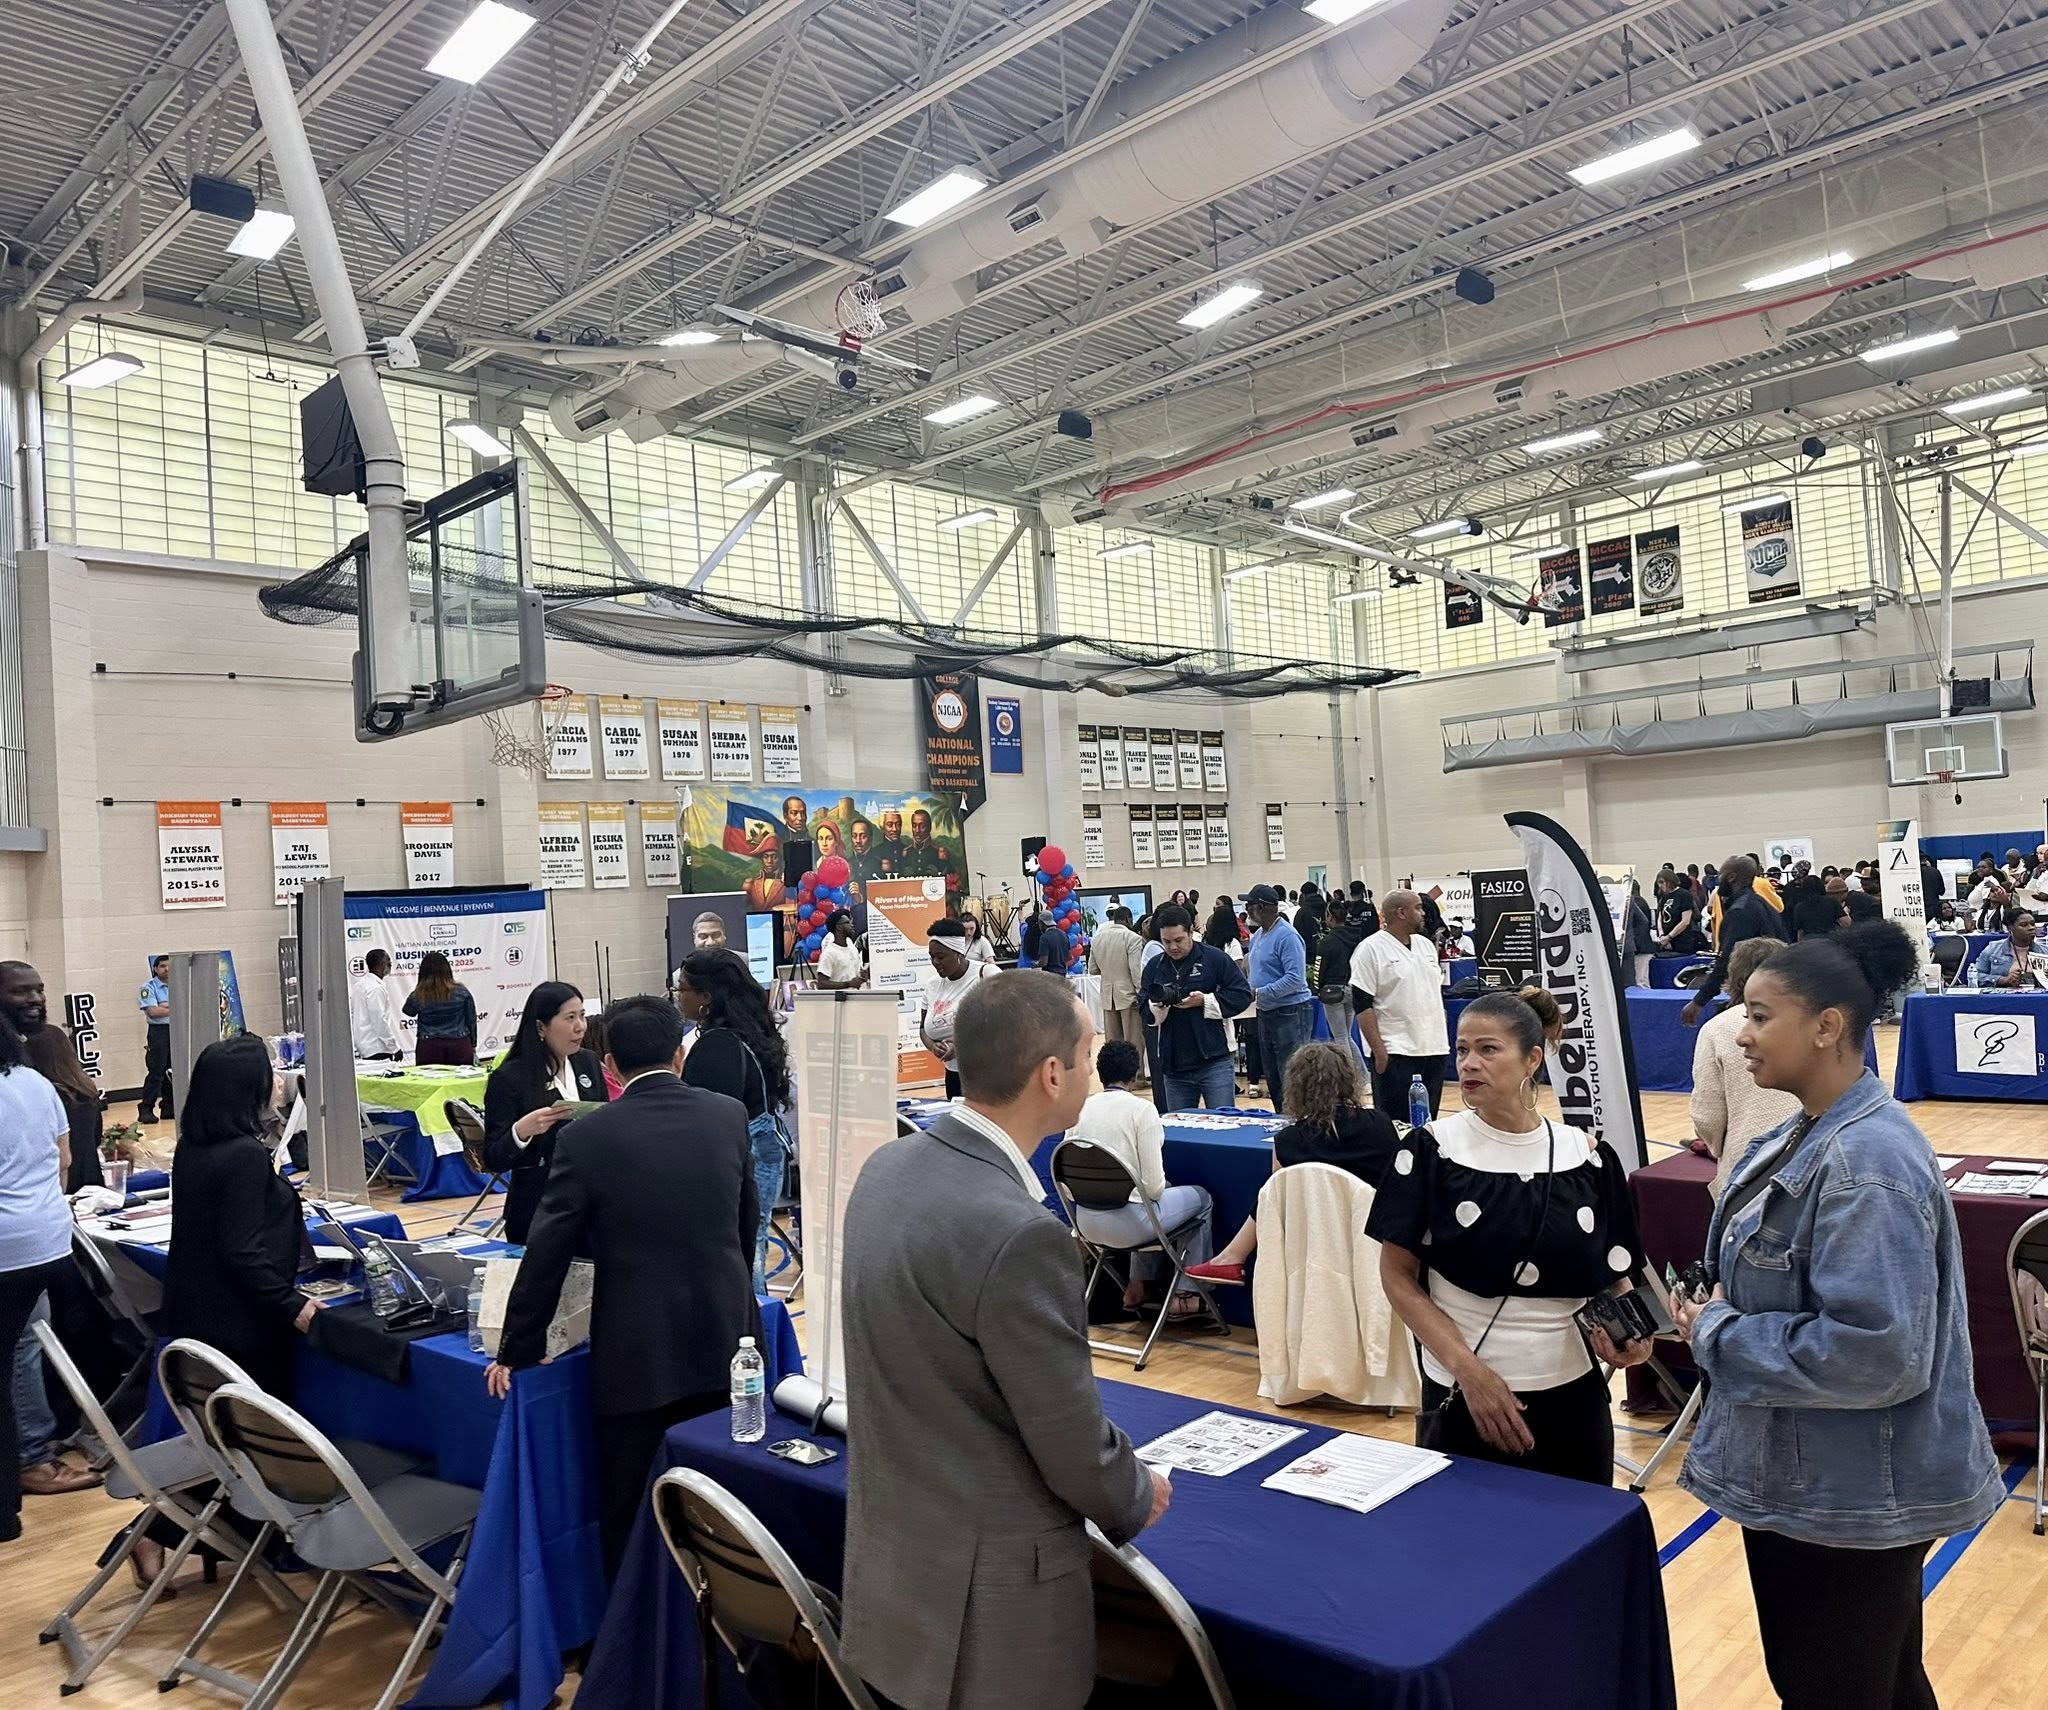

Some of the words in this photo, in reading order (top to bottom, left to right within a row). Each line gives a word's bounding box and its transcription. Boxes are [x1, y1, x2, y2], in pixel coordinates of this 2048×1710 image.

[1590, 541, 1630, 556] MCCAC
[1541, 554, 1579, 570] MCCAC
[1608, 592, 1633, 601] Place
[935, 675, 959, 684] COLLEGE
[938, 704, 962, 716] NJCAA
[605, 727, 641, 737] CAROL
[662, 729, 698, 740] SUSAN
[546, 736, 588, 744] ILLIAMS
[610, 737, 638, 745] LEWIS
[712, 732, 747, 742] SHEBRA
[764, 734, 795, 744] SUSAN
[663, 739, 699, 747] SUMMONS
[763, 743, 798, 751] SUMMONS
[928, 738, 974, 752] NATIONAL
[558, 748, 577, 756] 1977
[615, 749, 634, 757] 1977
[712, 753, 750, 761] 1978-1979
[926, 754, 980, 766] CHAMPIONS
[946, 778, 978, 786] BASKETBALL
[539, 836, 580, 845] ALFREDA
[593, 834, 624, 844] JESIKA
[645, 834, 674, 842] TYLER
[170, 846, 212, 855] ALYSSA
[291, 844, 310, 853] TAJ
[405, 842, 453, 851] BROOKLIN
[542, 845, 576, 853] HARRIS
[593, 843, 623, 851] HOLMES
[645, 842, 676, 850] KIMBALL
[164, 855, 220, 864] STEWART
[285, 853, 318, 862] LEWIS
[413, 851, 442, 859] DAVIS
[598, 855, 620, 863] 2011
[415, 873, 441, 882] 2017
[167, 879, 220, 890] 2015-16
[279, 876, 326, 889] 2015
[1480, 880, 1524, 894] FASIZO
[1902, 884, 1920, 893] WEAR
[1447, 889, 1473, 900] KOH
[875, 896, 898, 904] Rivers
[898, 895, 907, 903] of
[907, 895, 925, 904] Hope
[1904, 895, 1921, 905] YOUR
[385, 905, 420, 914] WELCOME
[423, 904, 460, 913] BIENVENUE
[463, 902, 495, 911] BYENVENI
[1893, 907, 1923, 917] CULTURE
[504, 922, 527, 934] QTS
[347, 927, 372, 939] QTS
[395, 949, 450, 960] BUSINS
[452, 947, 482, 957] EXPO
[396, 962, 415, 971] AND
[455, 959, 475, 967] 2025
[1576, 949, 1586, 980] INC.
[1579, 986, 1604, 1127] PSYCHOTHERAPY,
